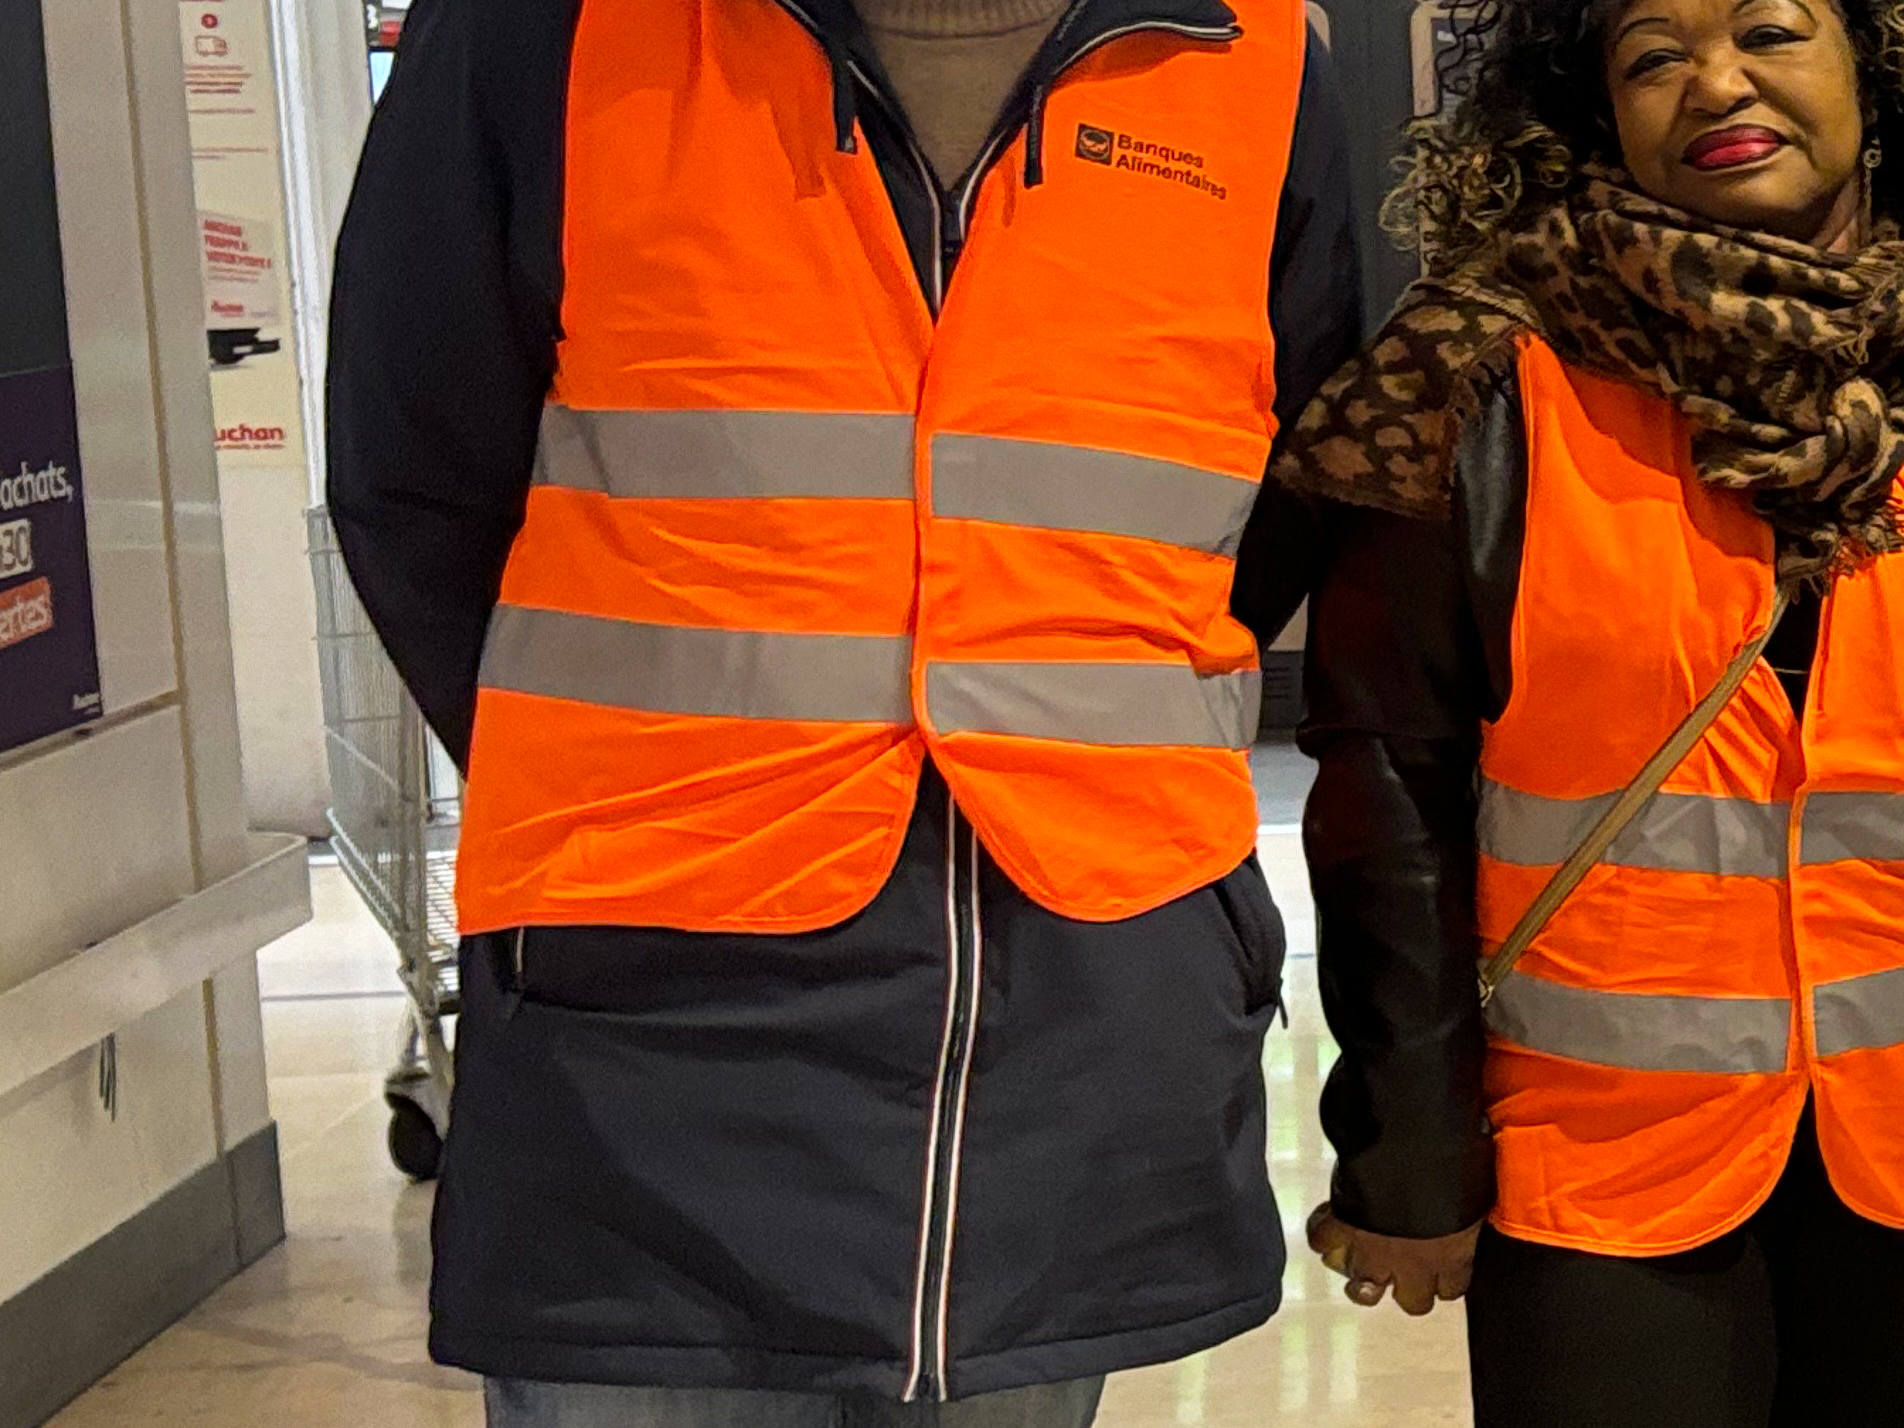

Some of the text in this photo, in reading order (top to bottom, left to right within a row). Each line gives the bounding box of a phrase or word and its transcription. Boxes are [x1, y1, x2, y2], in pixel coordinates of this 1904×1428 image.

[1117, 134, 1204, 168] Banques
[1116, 154, 1227, 201] Alimentaires
[0, 459, 74, 511] achats,
